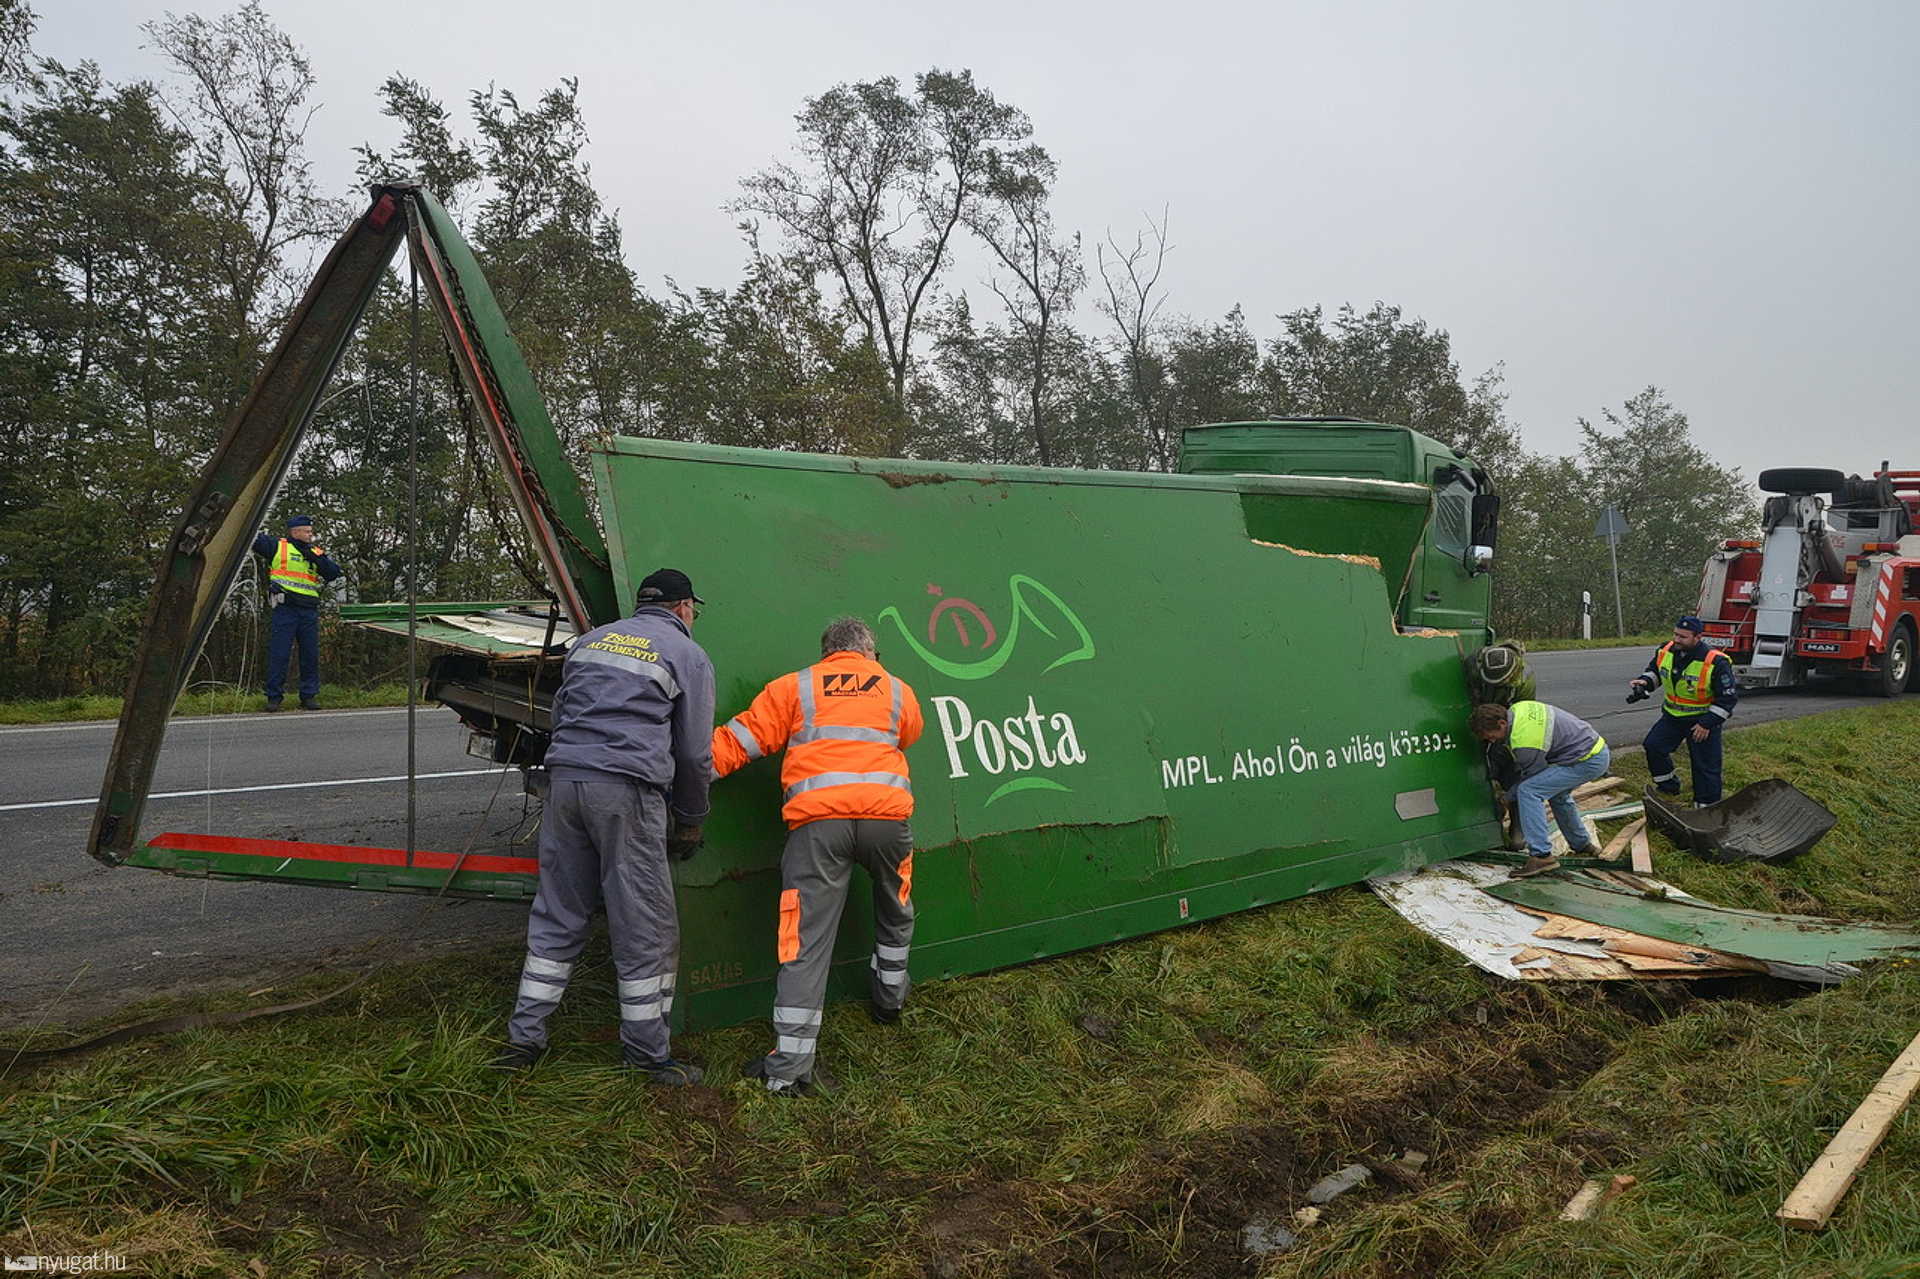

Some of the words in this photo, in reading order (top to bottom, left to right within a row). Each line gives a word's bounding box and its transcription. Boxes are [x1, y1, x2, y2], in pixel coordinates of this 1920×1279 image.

[930, 695, 1087, 779] Posta
[1161, 756, 1223, 789] MPL.
[1232, 745, 1284, 780] Ahol
[1288, 737, 1319, 773] Ön
[1325, 749, 1337, 769] a
[1340, 734, 1386, 768] világ
